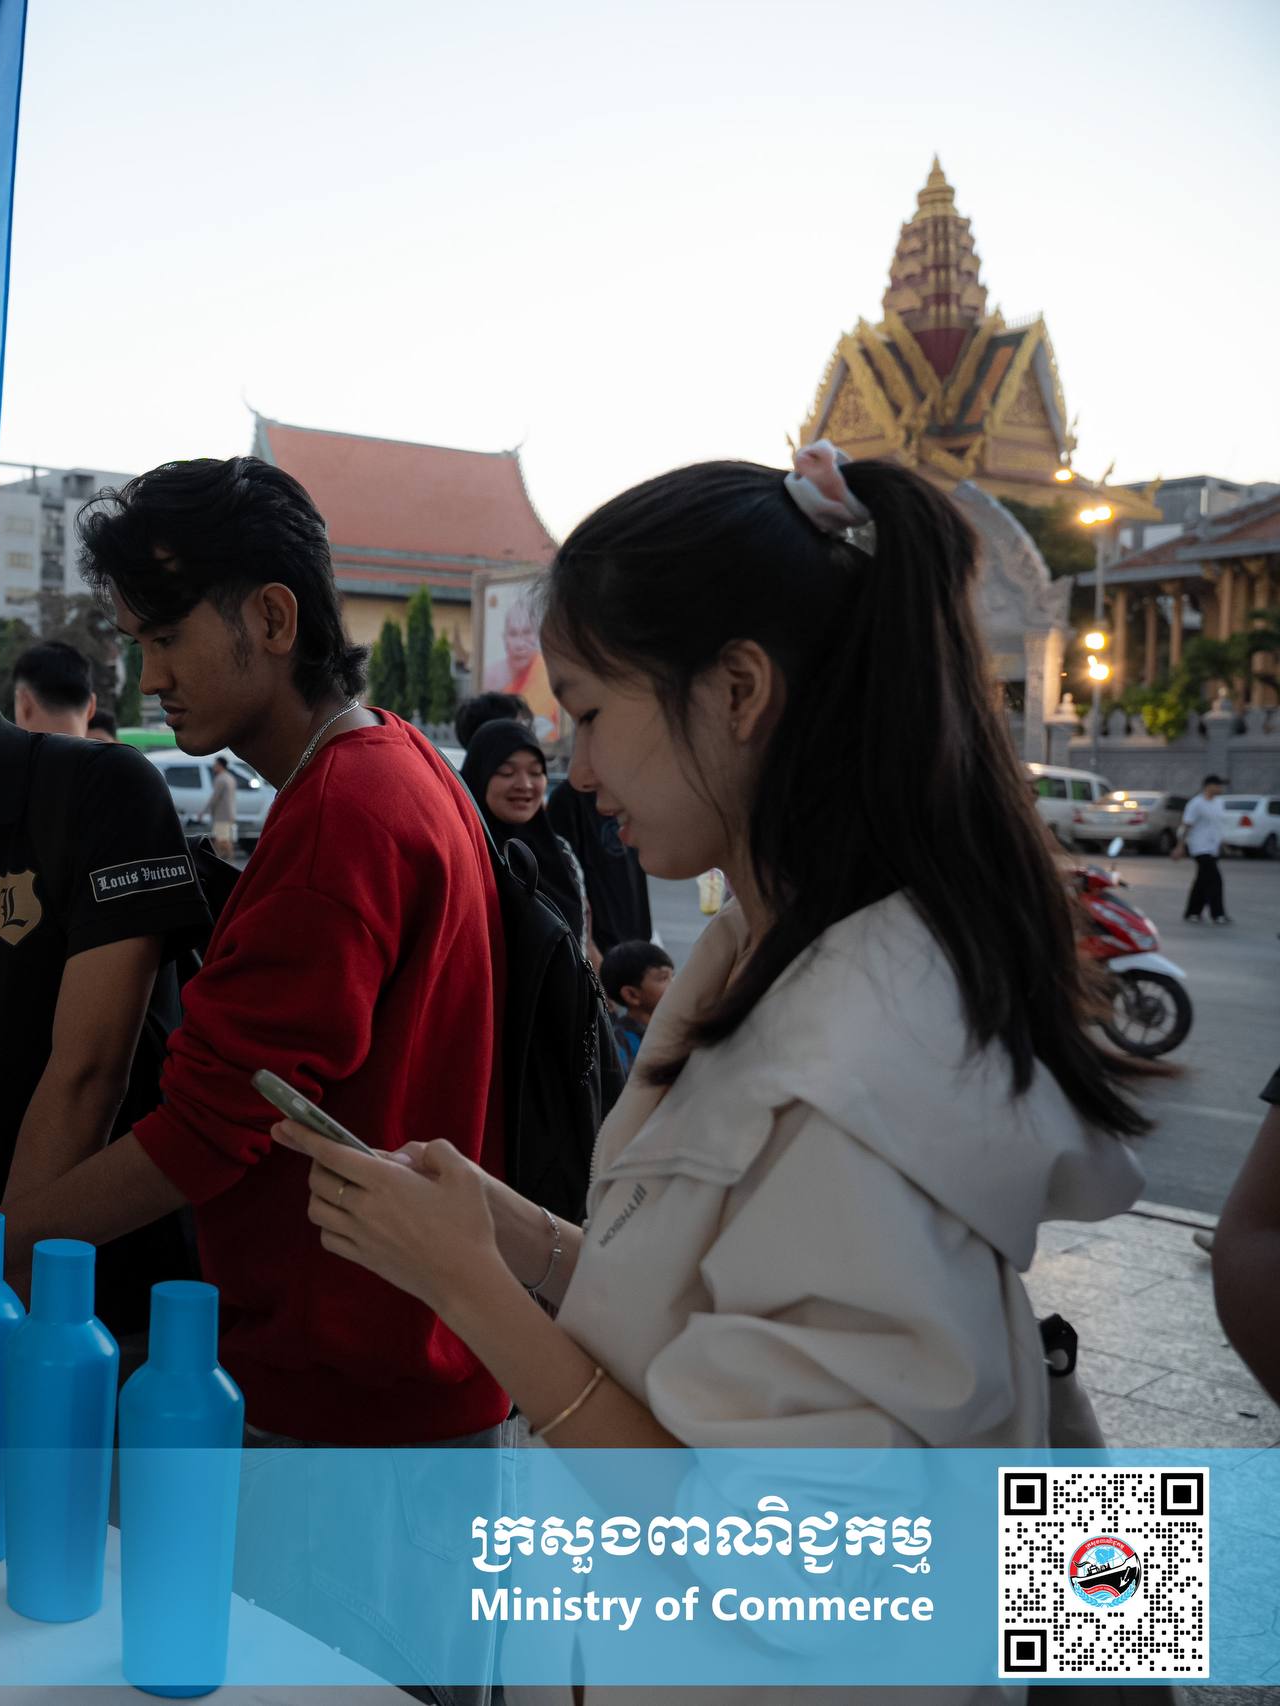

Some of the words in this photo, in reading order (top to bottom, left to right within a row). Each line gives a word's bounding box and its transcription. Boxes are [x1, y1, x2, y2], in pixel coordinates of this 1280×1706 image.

[97, 871, 139, 892] Louis
[140, 864, 187, 882] Vuitton
[0, 885, 29, 929] L
